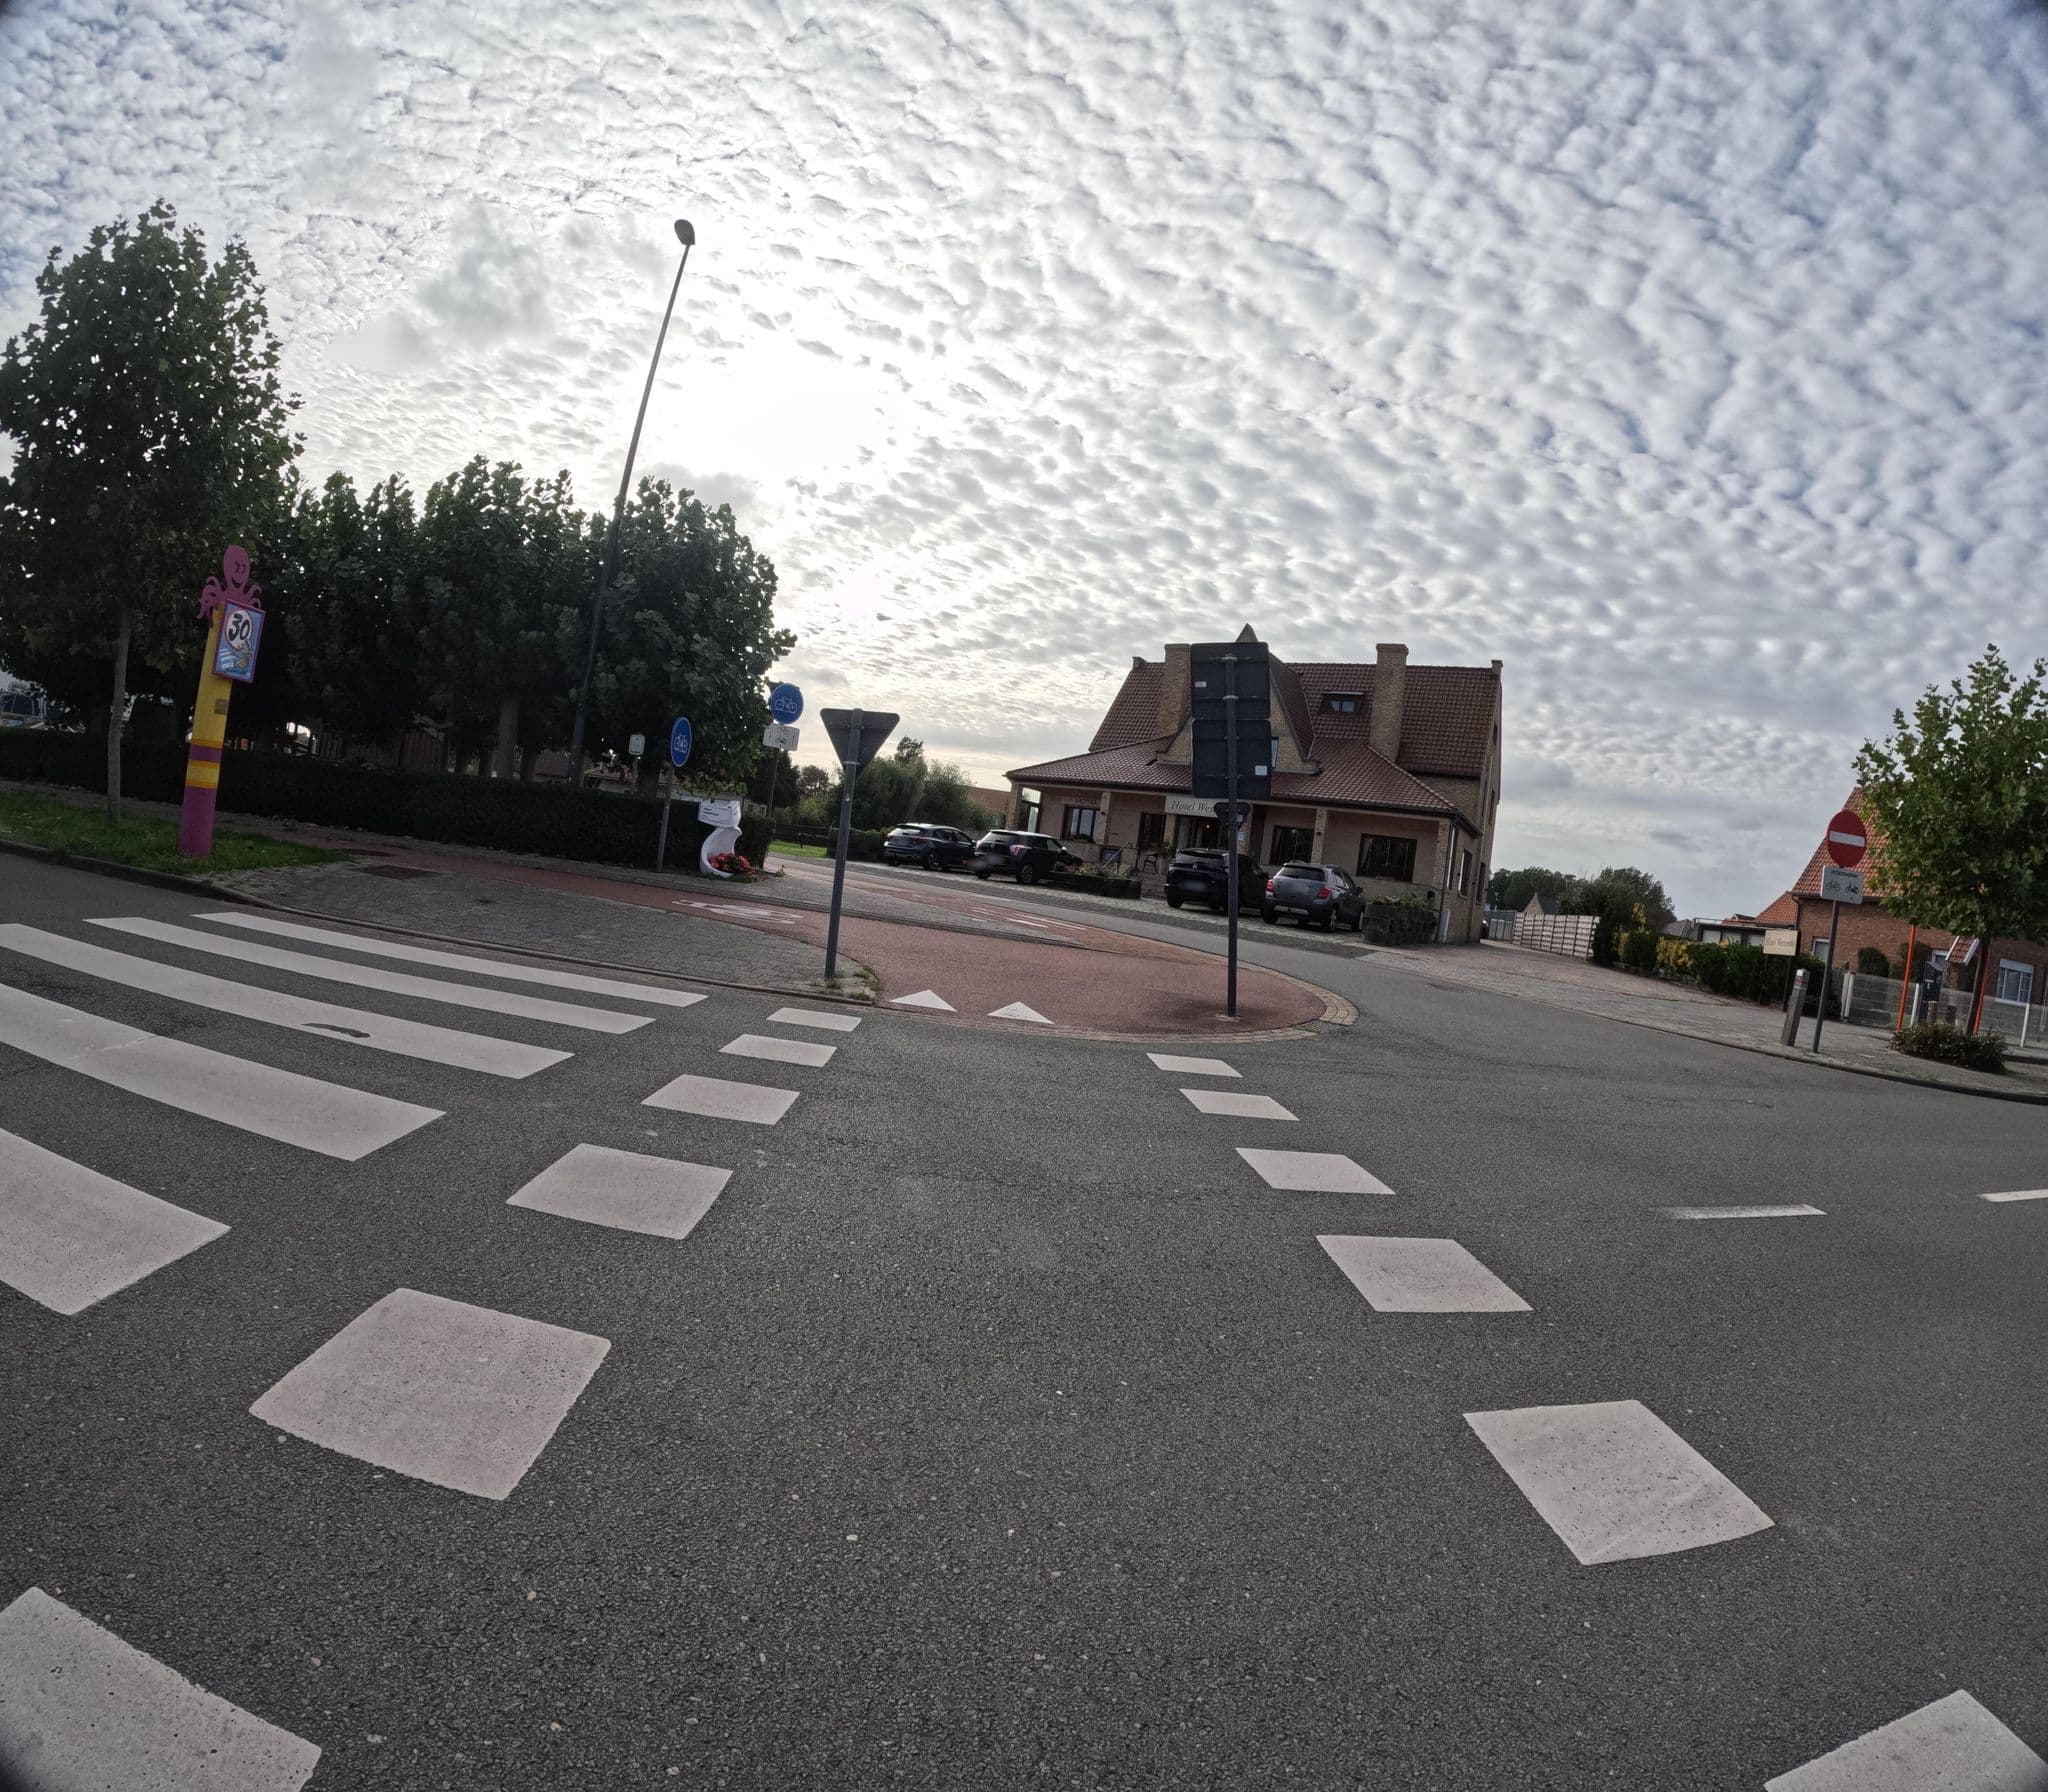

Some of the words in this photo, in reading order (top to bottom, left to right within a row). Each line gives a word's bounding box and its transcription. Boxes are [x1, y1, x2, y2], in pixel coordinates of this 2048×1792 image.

[228, 613, 251, 642] 30
[1172, 800, 1195, 812] Hotel
[1197, 802, 1215, 813] Wes
